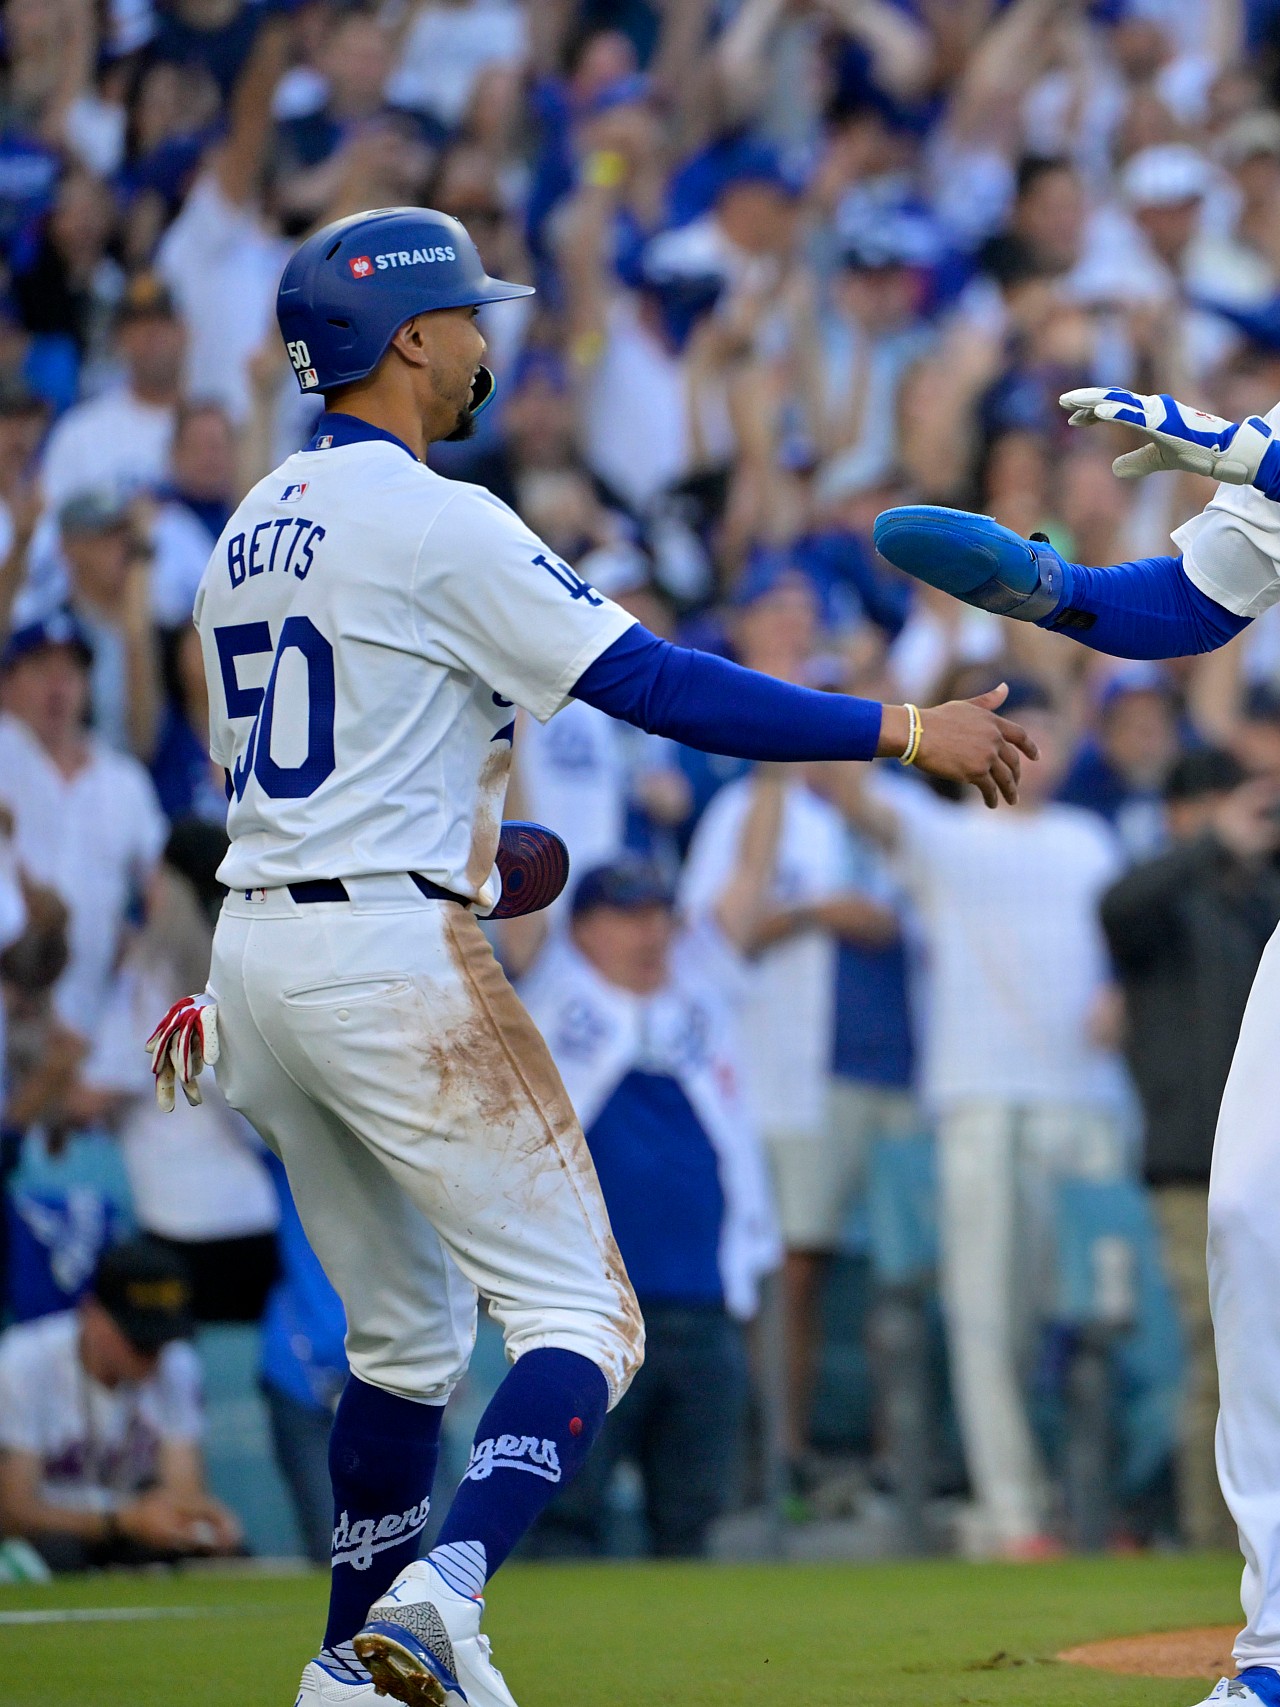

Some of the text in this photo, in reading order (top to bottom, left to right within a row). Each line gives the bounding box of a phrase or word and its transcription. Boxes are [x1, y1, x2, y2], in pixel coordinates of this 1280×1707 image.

[375, 246, 456, 270] STRAUSS
[287, 340, 312, 369] 50
[228, 517, 326, 590] BETTS
[213, 615, 337, 804] 50
